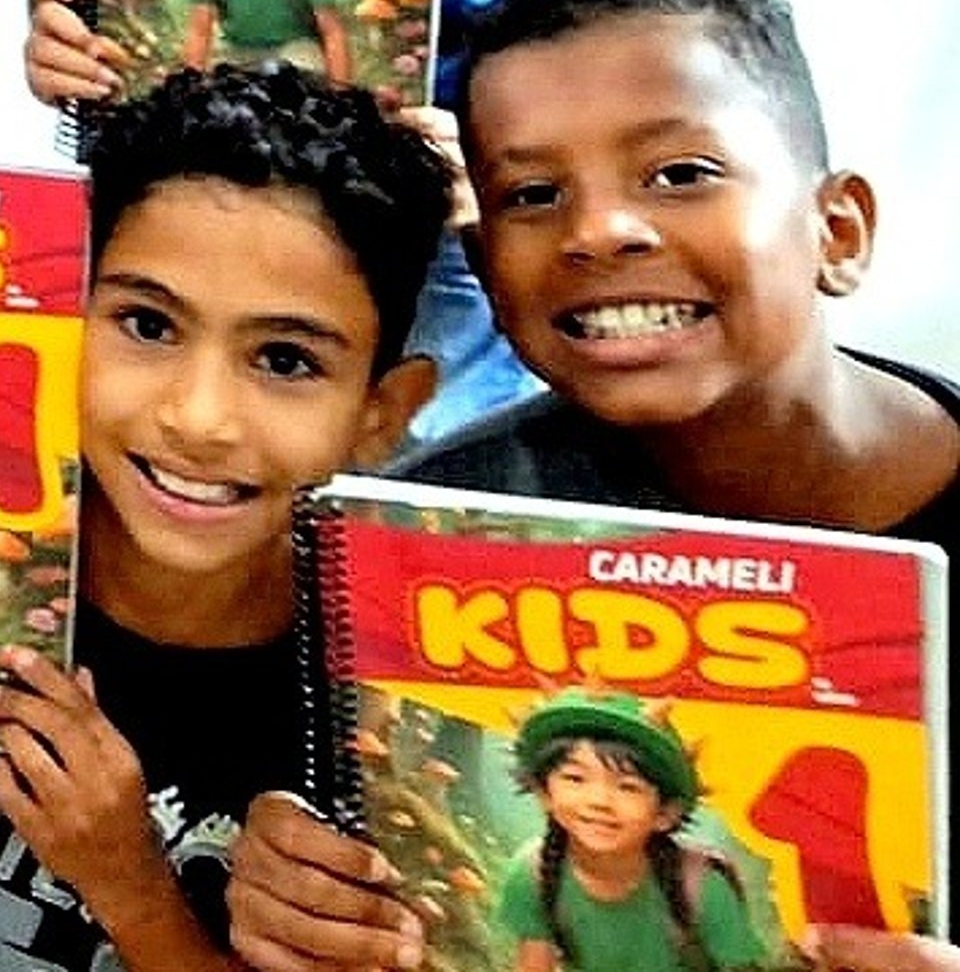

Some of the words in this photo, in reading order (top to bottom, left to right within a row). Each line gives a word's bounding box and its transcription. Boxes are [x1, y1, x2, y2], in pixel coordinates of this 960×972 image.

[588, 549, 797, 594] CARAMELI
[415, 585, 810, 690] KIDS
[748, 744, 888, 928] 1
